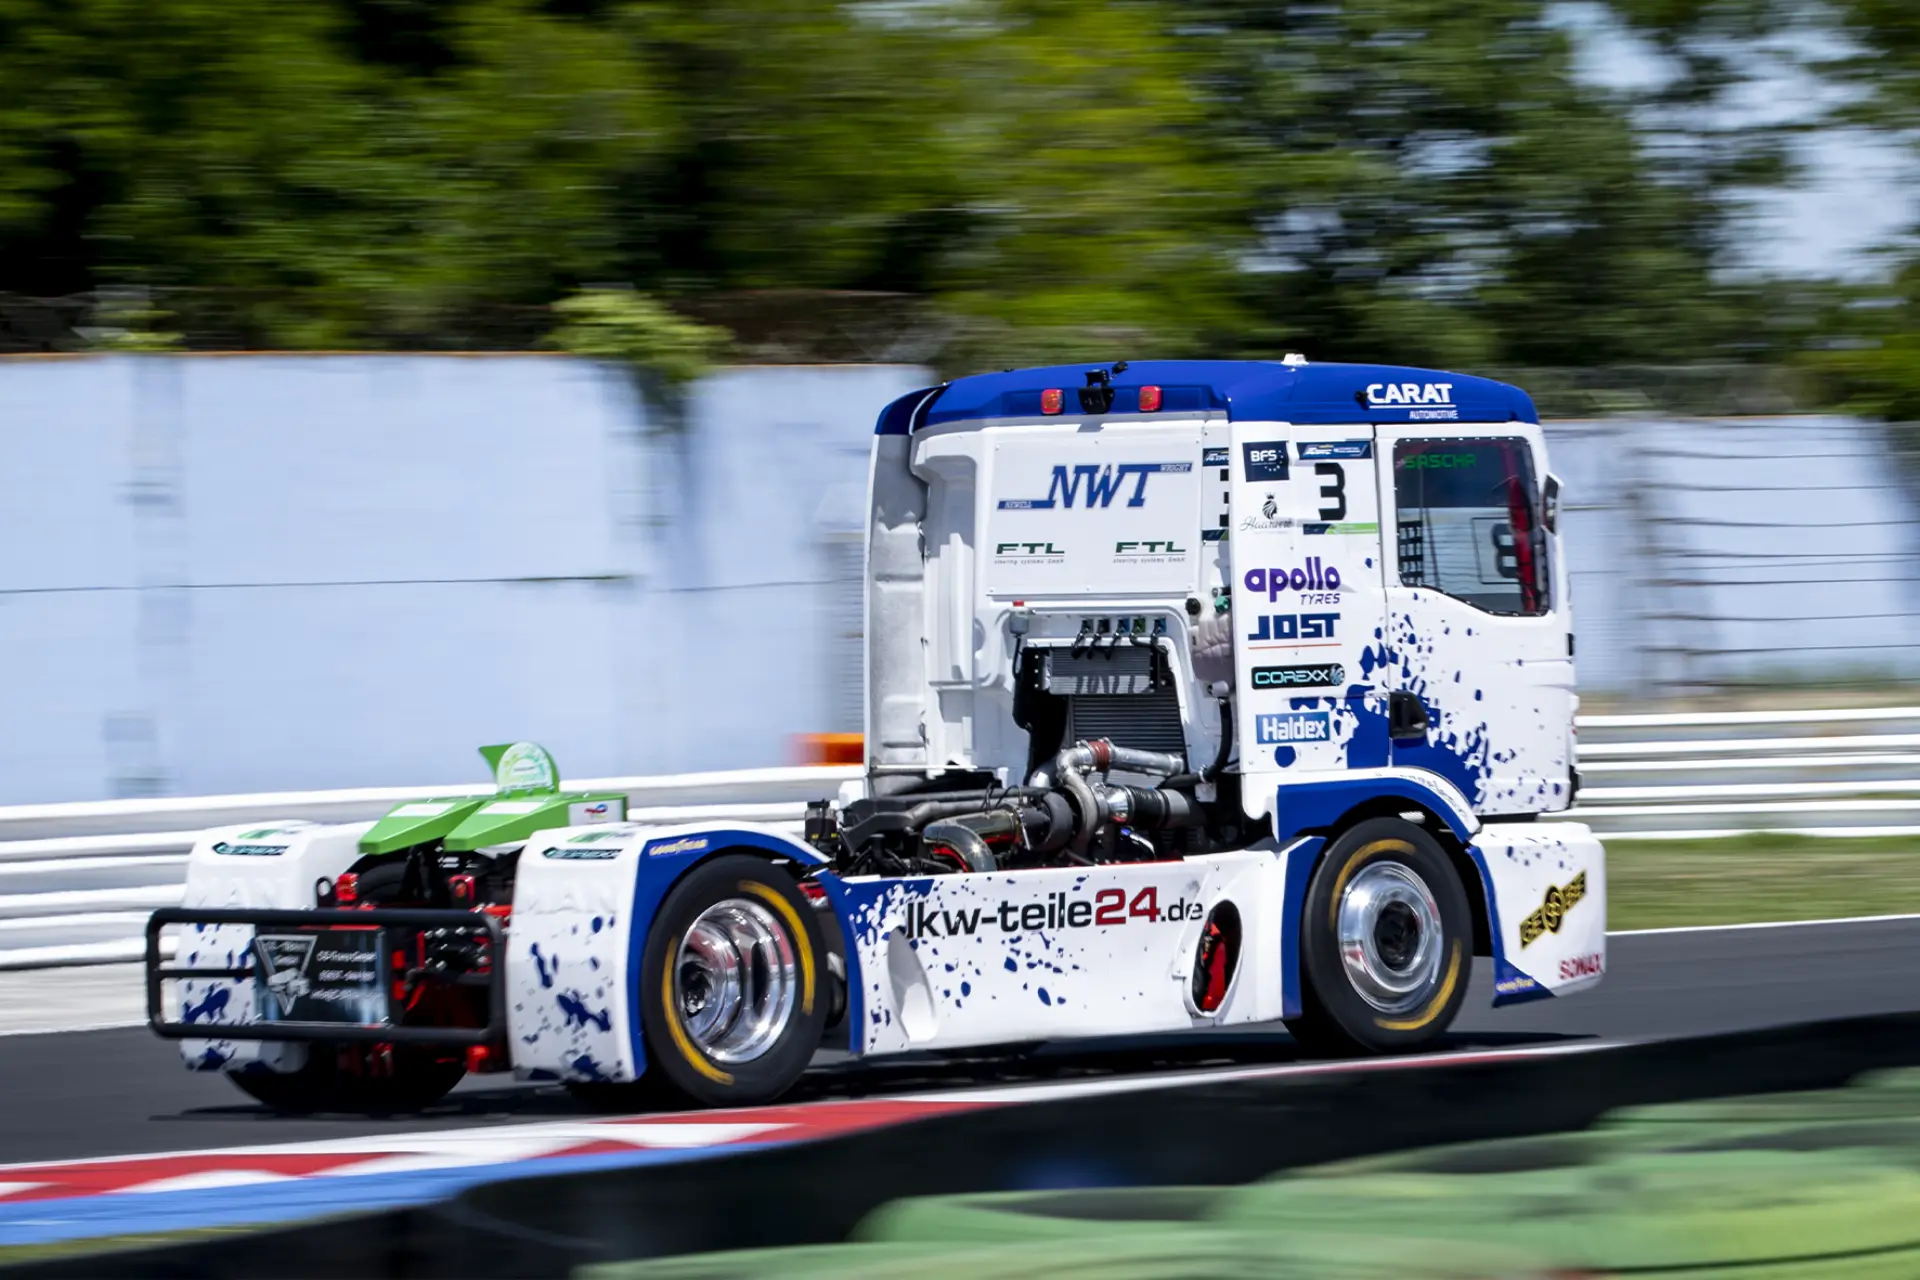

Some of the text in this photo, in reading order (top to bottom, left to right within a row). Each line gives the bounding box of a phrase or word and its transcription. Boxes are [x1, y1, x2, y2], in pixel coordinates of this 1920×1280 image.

[1366, 383, 1453, 404] CARAT
[1409, 410, 1459, 420] AUTOMOTIVE
[1250, 449, 1278, 462] BFS
[1046, 462, 1162, 509] NWT
[1314, 462, 1347, 521] 3
[996, 542, 1065, 554] FTL
[1115, 541, 1186, 553] FTL
[1244, 556, 1341, 603] apollo
[1300, 593, 1341, 605] TYRES
[1247, 612, 1341, 641] JOST
[1254, 669, 1330, 685] COREXX
[1262, 716, 1326, 741] Haldex
[906, 886, 1203, 939] lkw-teile24.de
